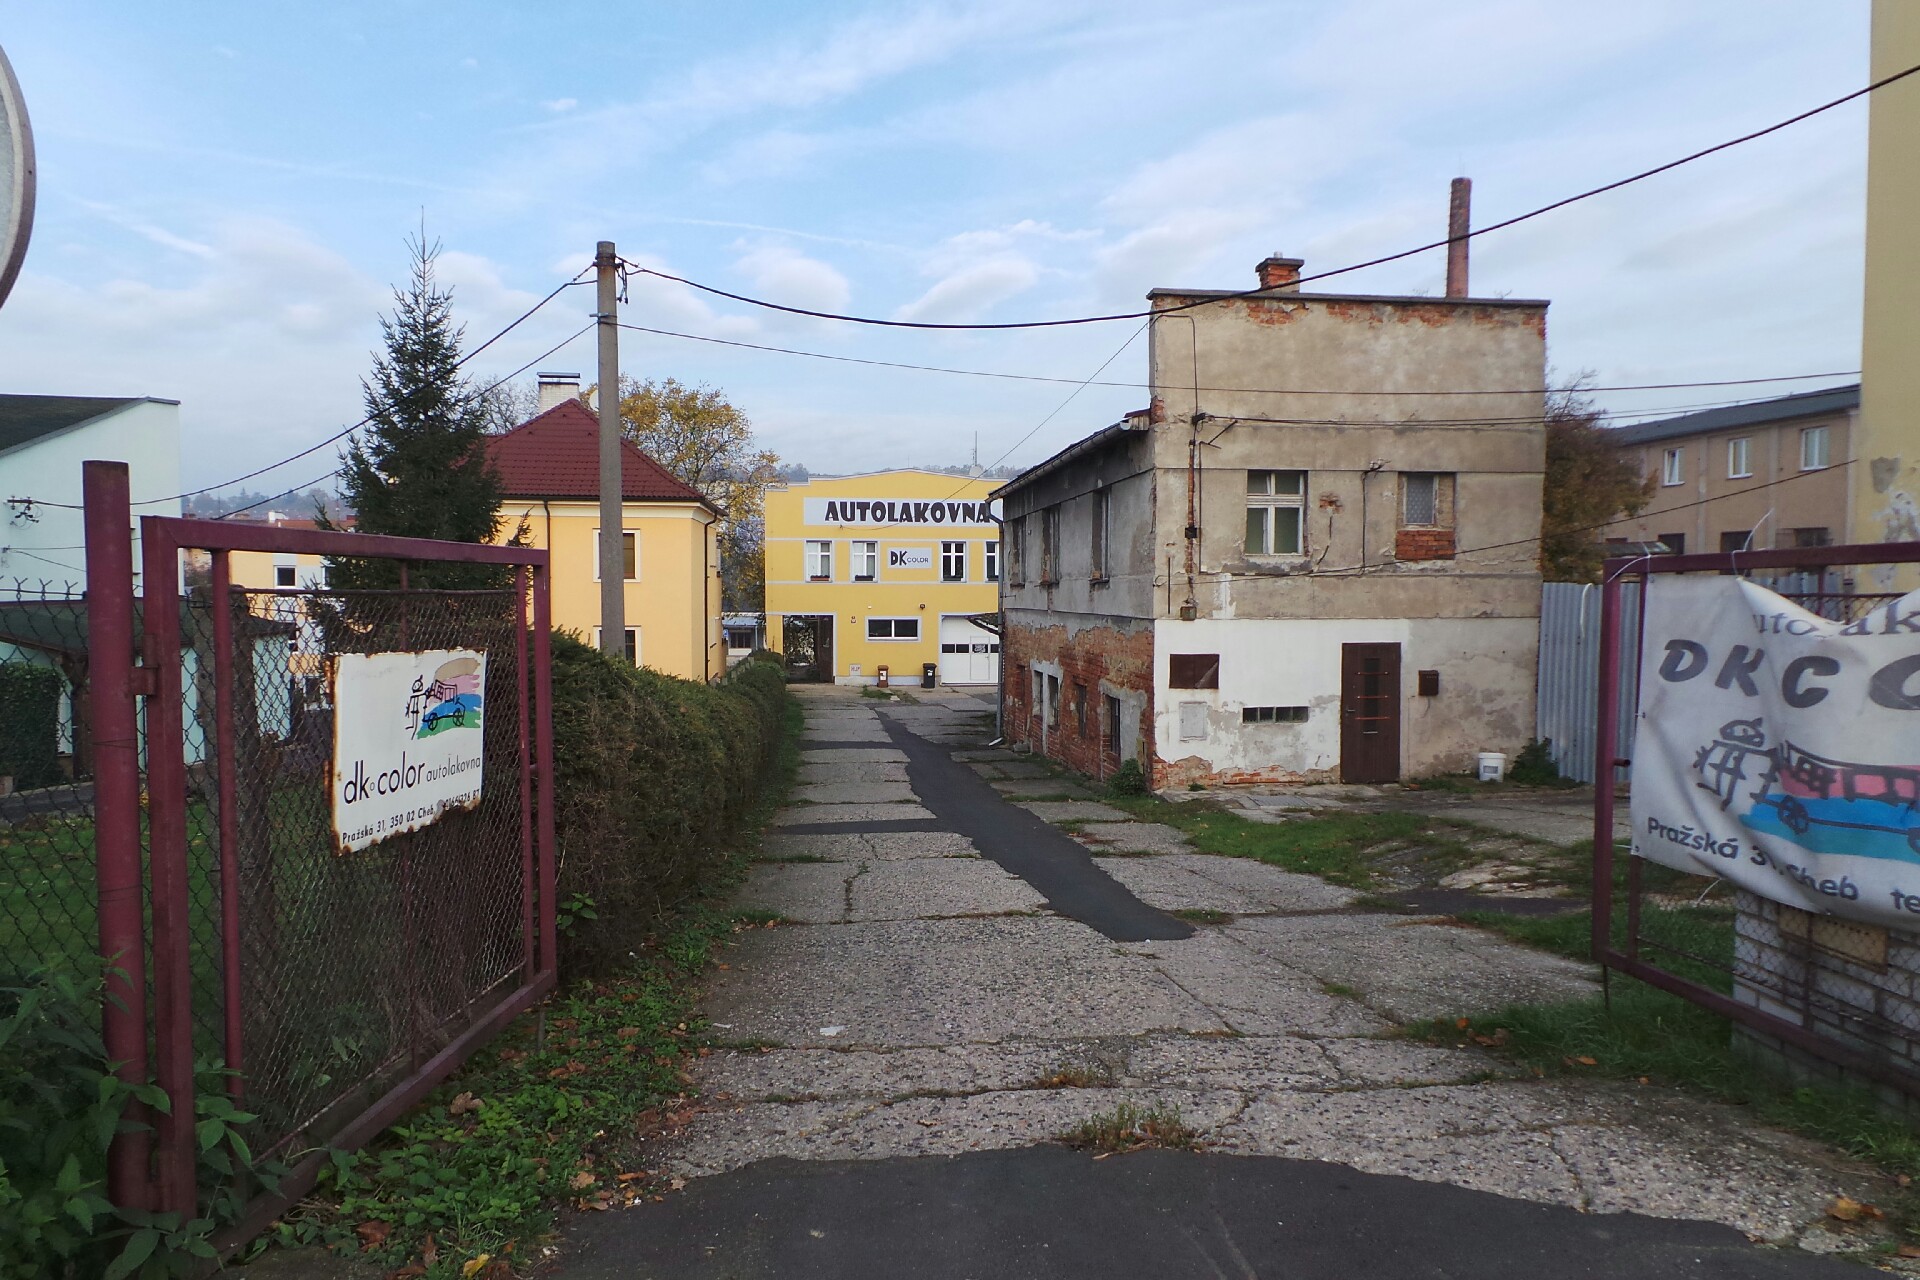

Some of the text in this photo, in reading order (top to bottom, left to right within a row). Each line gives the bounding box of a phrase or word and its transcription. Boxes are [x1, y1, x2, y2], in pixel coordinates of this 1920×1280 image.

[825, 501, 991, 523] AUTOLAKOVNA
[890, 550, 907, 566] DK
[427, 754, 480, 782] autolakovna
[390, 814, 404, 829] 350
[407, 810, 415, 822] 02
[1648, 817, 1738, 859] Pražská
